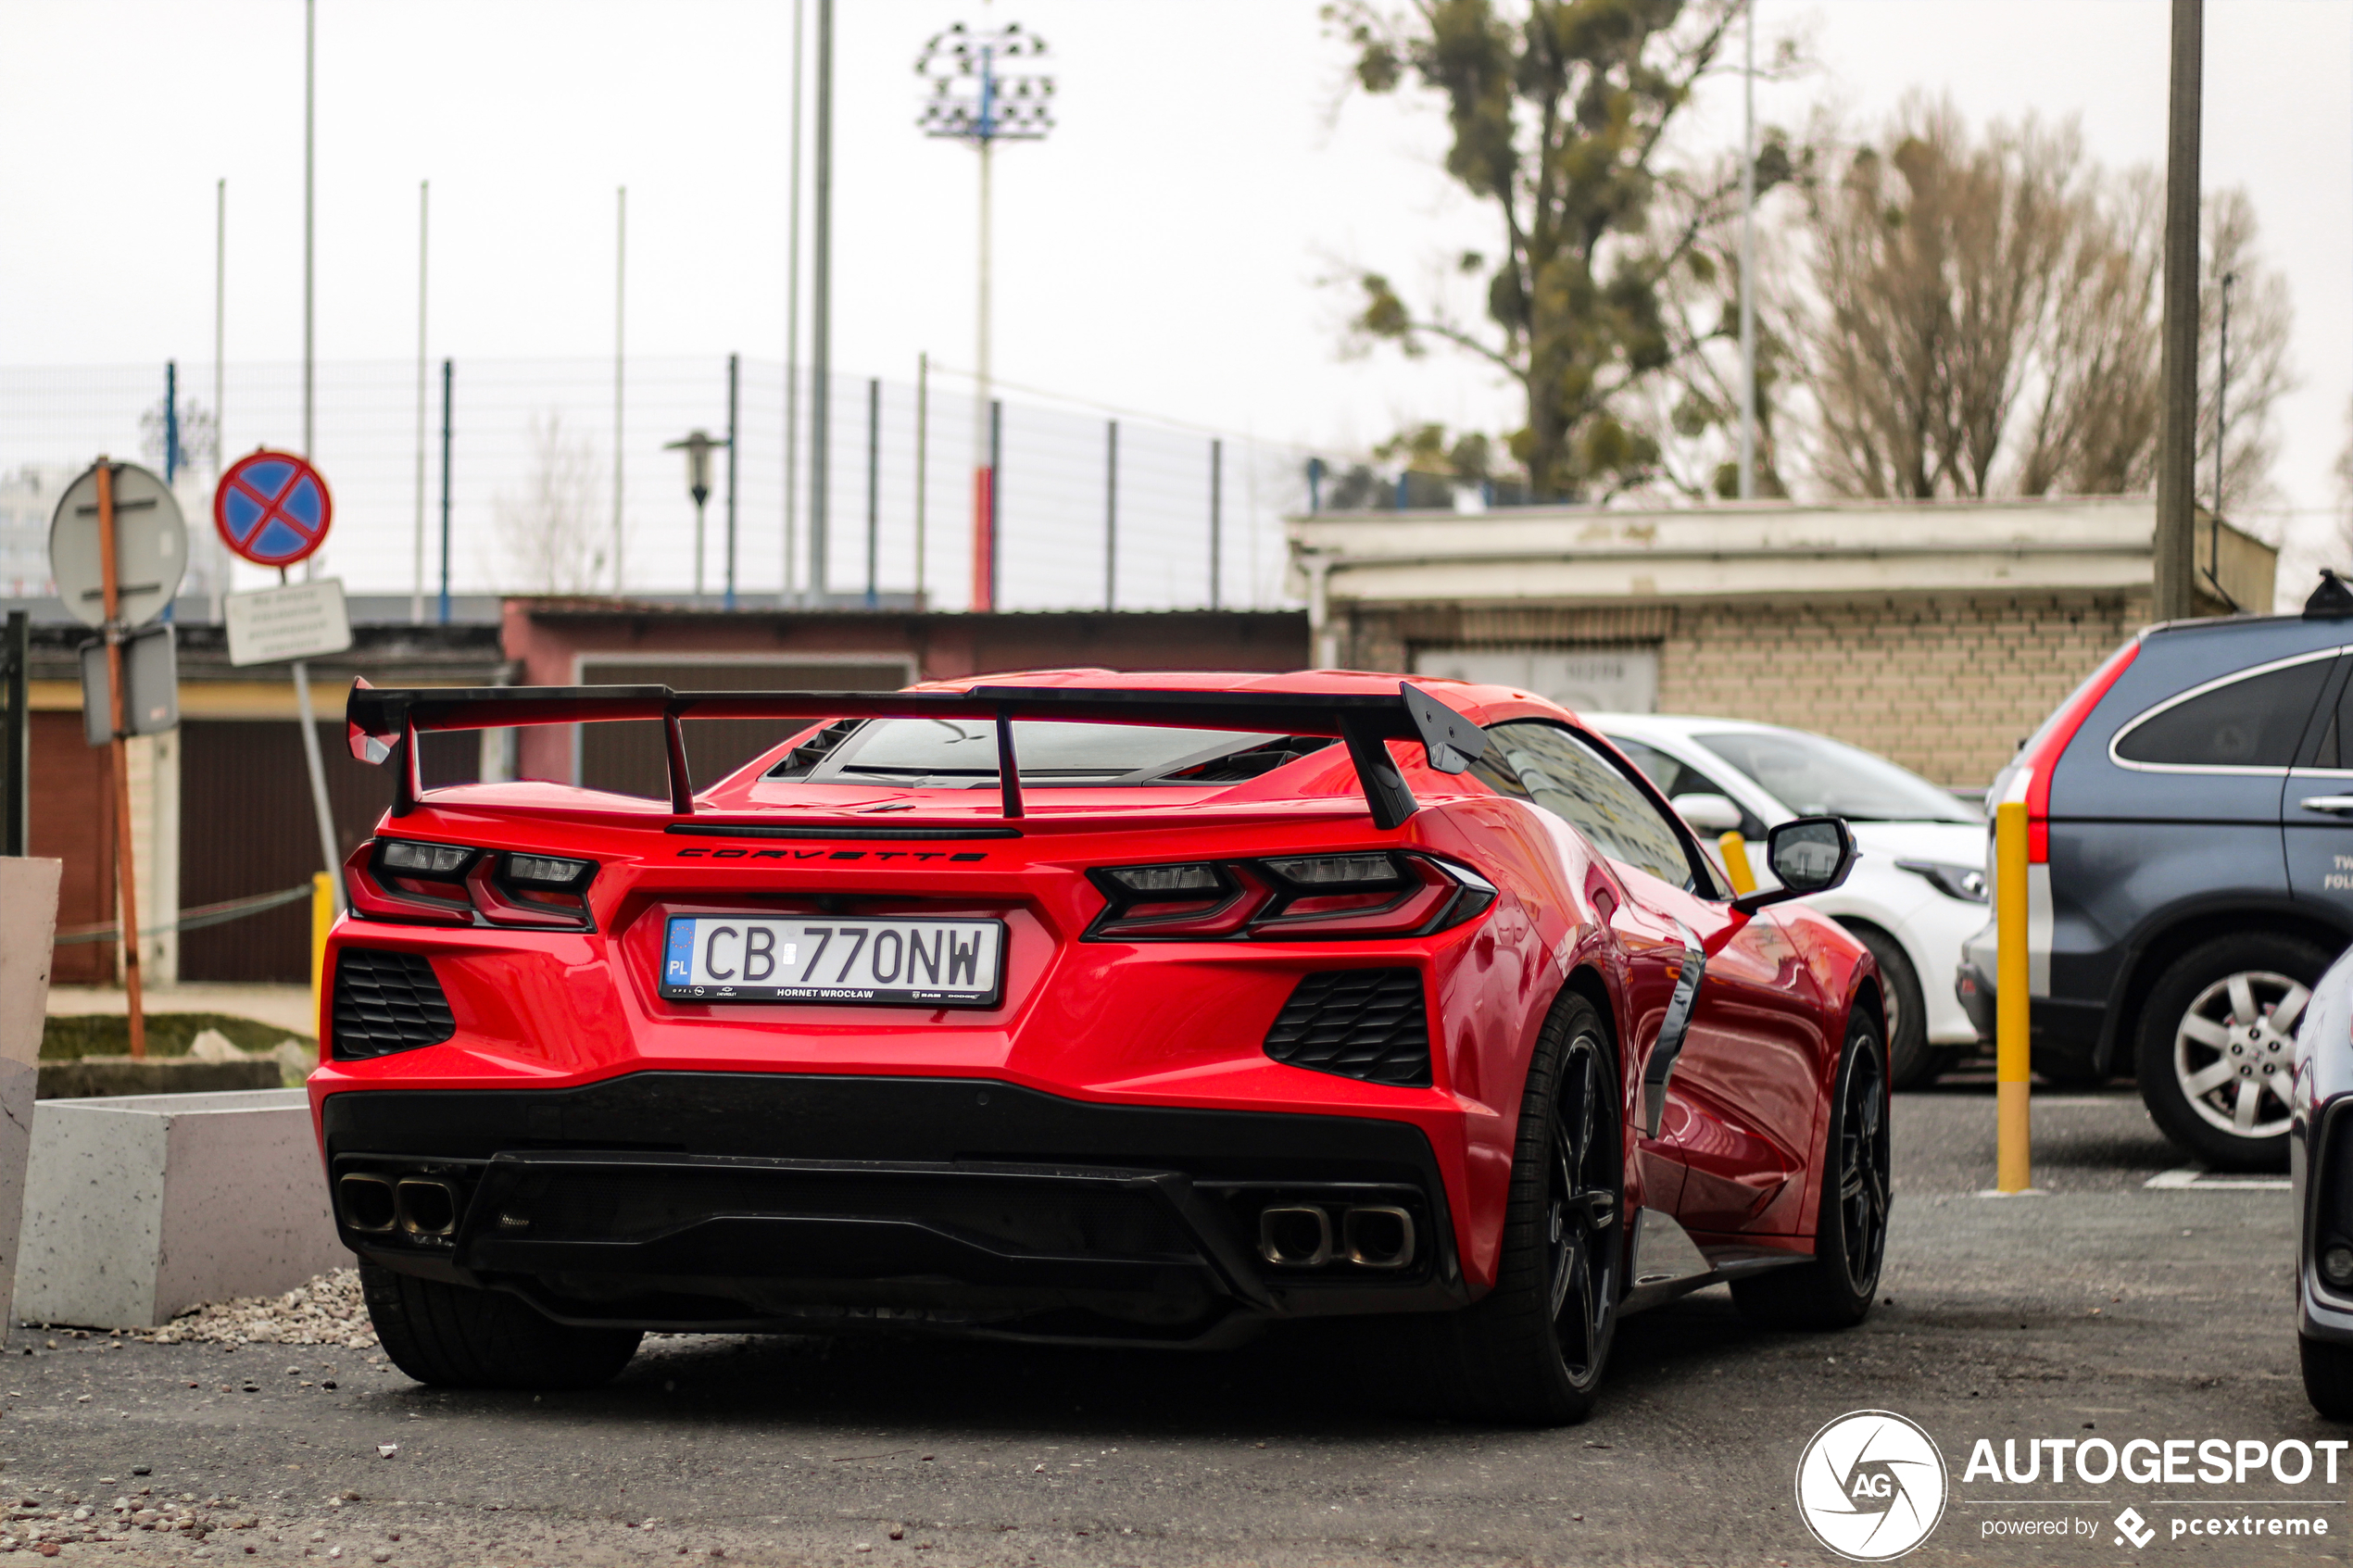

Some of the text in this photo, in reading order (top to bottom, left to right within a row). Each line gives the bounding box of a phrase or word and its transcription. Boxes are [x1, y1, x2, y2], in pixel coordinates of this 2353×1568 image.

[676, 847, 988, 862] CORVETTE
[706, 926, 981, 985] CB 770NW
[669, 960, 688, 975] PL
[776, 988, 875, 998] HORNET WROCŁAW
